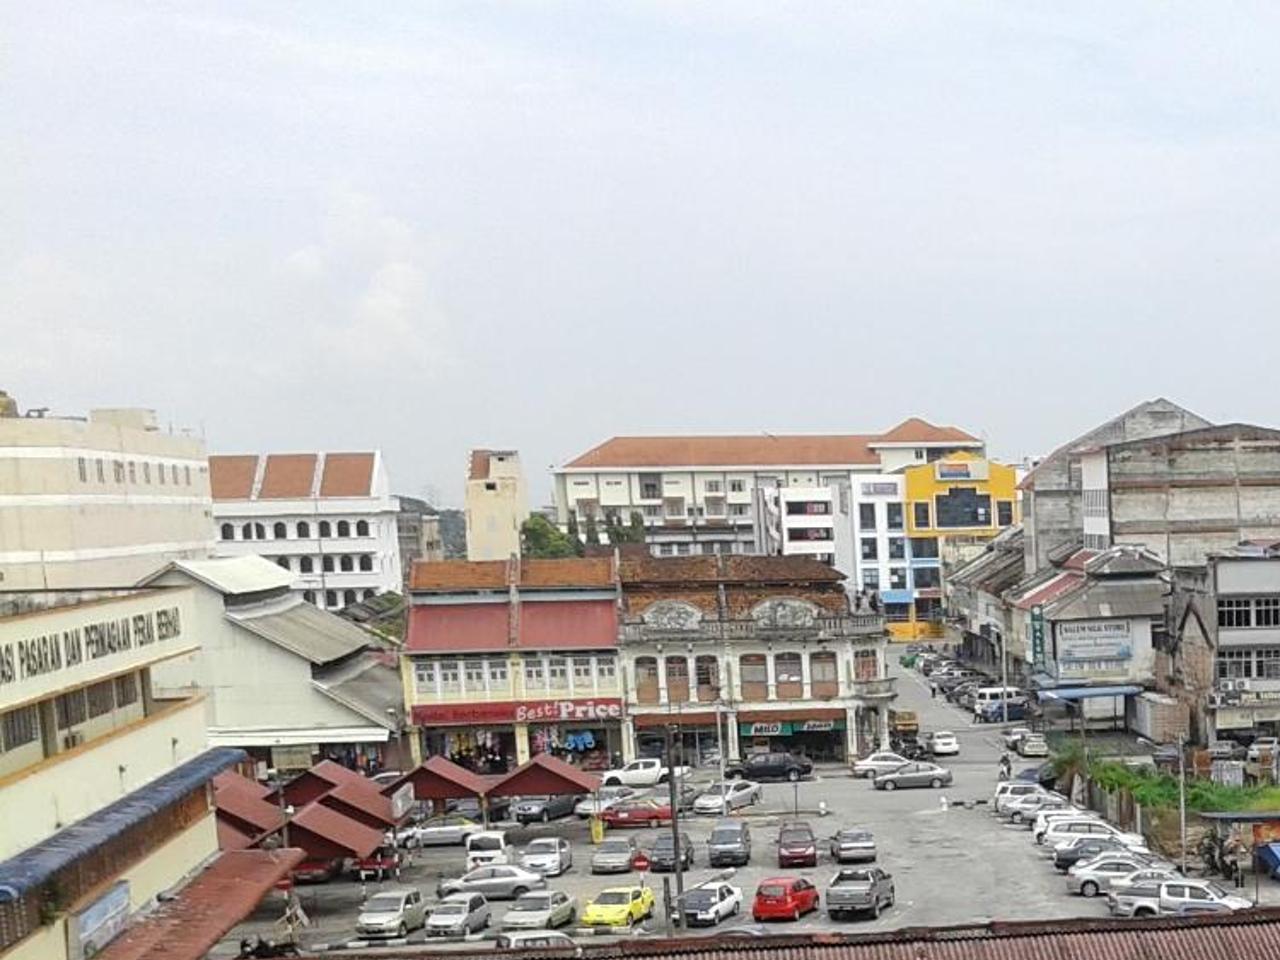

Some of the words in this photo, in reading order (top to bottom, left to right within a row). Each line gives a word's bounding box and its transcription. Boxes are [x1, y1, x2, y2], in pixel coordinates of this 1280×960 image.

[18, 633, 62, 680] PASARAN
[64, 628, 82, 667] DAN
[559, 700, 621, 719] Price
